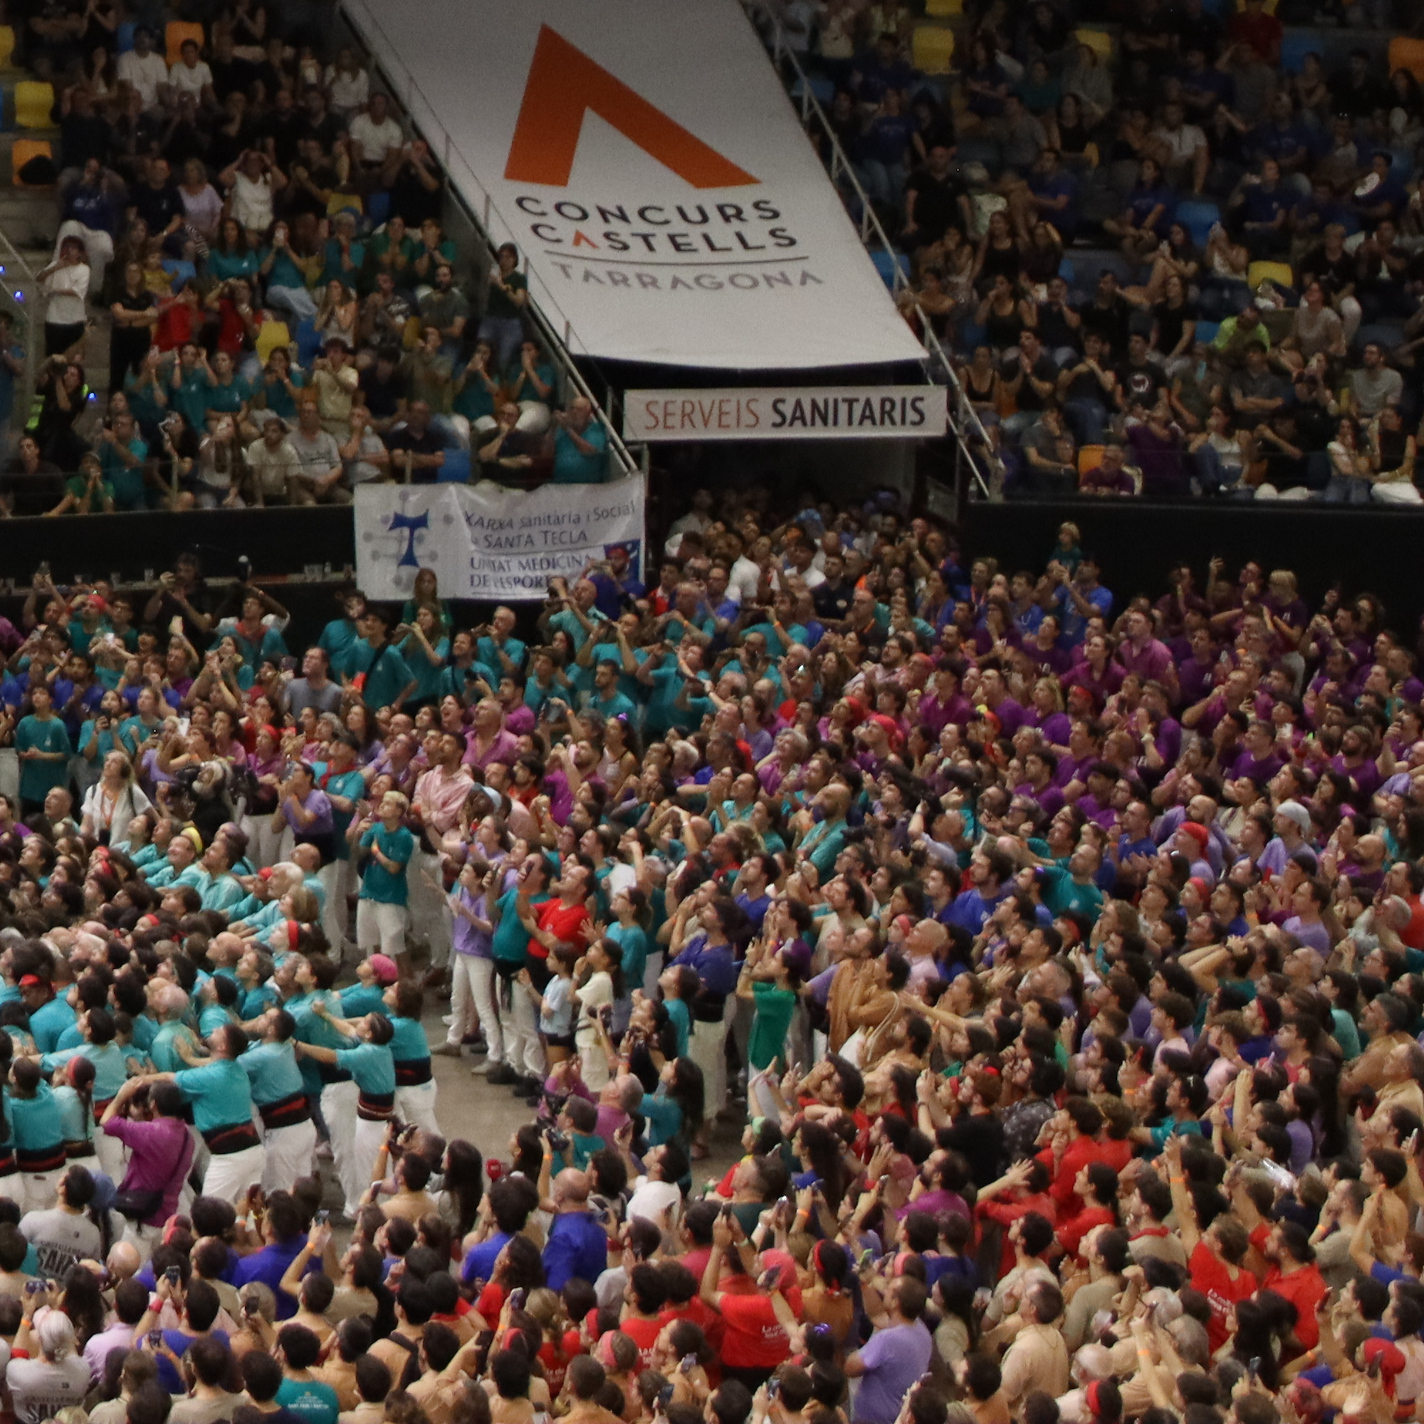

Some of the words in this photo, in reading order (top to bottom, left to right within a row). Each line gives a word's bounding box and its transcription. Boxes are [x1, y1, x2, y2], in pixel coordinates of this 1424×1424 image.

[514, 195, 783, 224] CONCURS
[530, 221, 799, 253] CASTELLS
[552, 261, 824, 292] TARRAGONA
[644, 398, 761, 430] SERVEIS
[770, 395, 926, 429] SANITARIS
[464, 511, 514, 531] XARXA
[593, 500, 636, 522] Social
[484, 533, 535, 549] SANTA
[542, 530, 588, 546] TECLA
